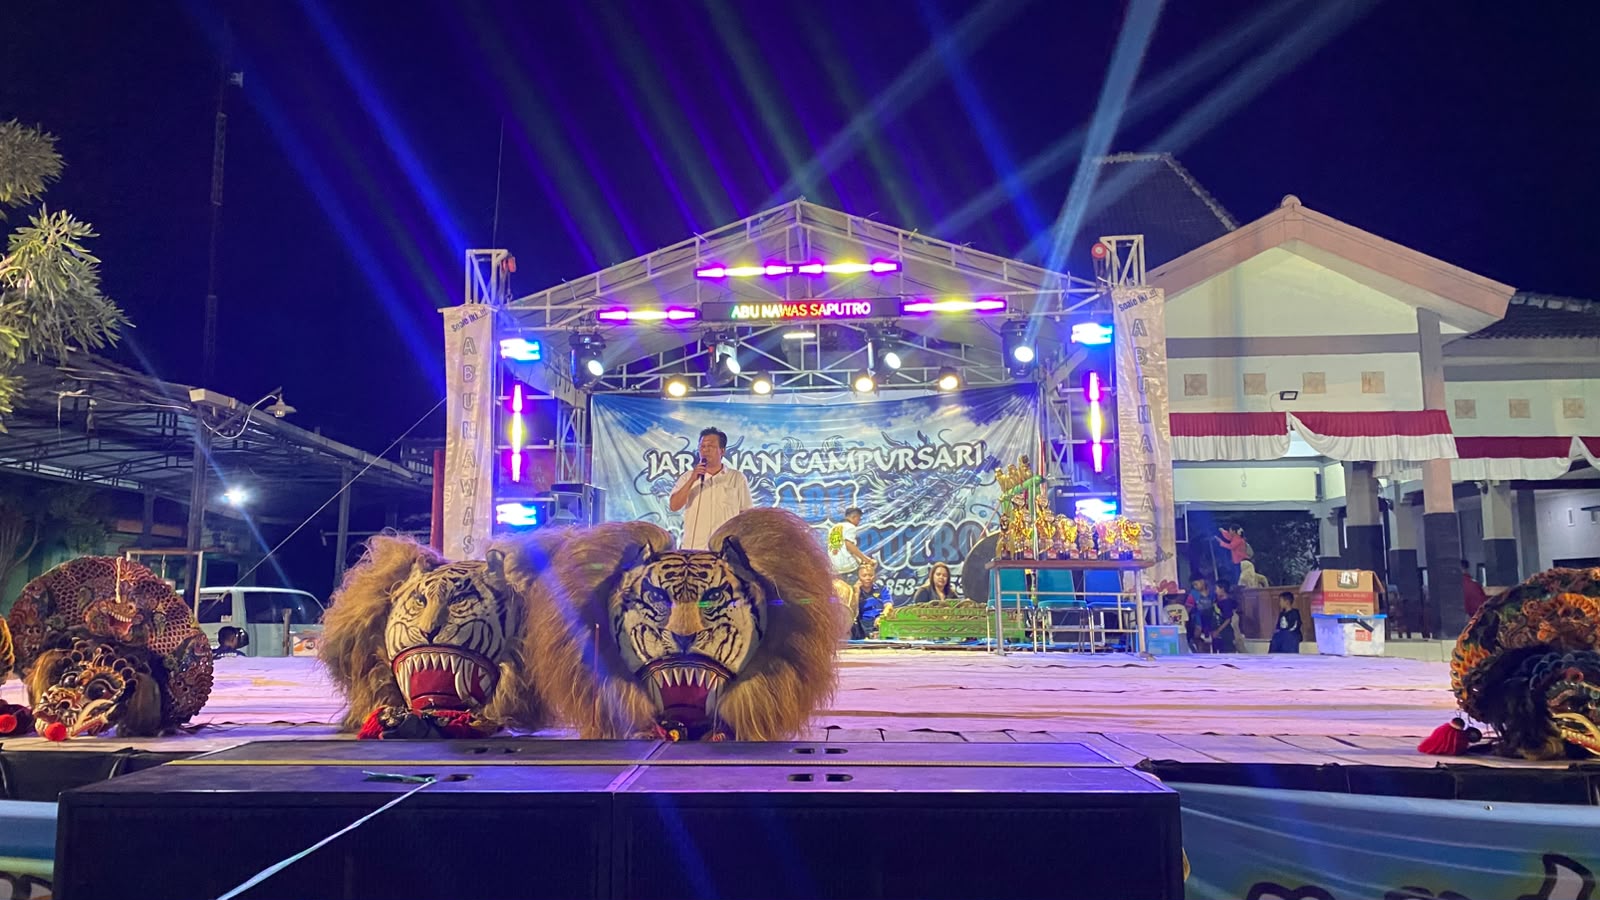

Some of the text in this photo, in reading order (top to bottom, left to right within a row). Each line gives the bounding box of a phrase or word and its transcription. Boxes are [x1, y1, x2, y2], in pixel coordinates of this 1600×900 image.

[731, 301, 871, 319] ABU NAWAS SAPUTRO
[648, 440, 984, 480] JARNAN CAMPURSARI
